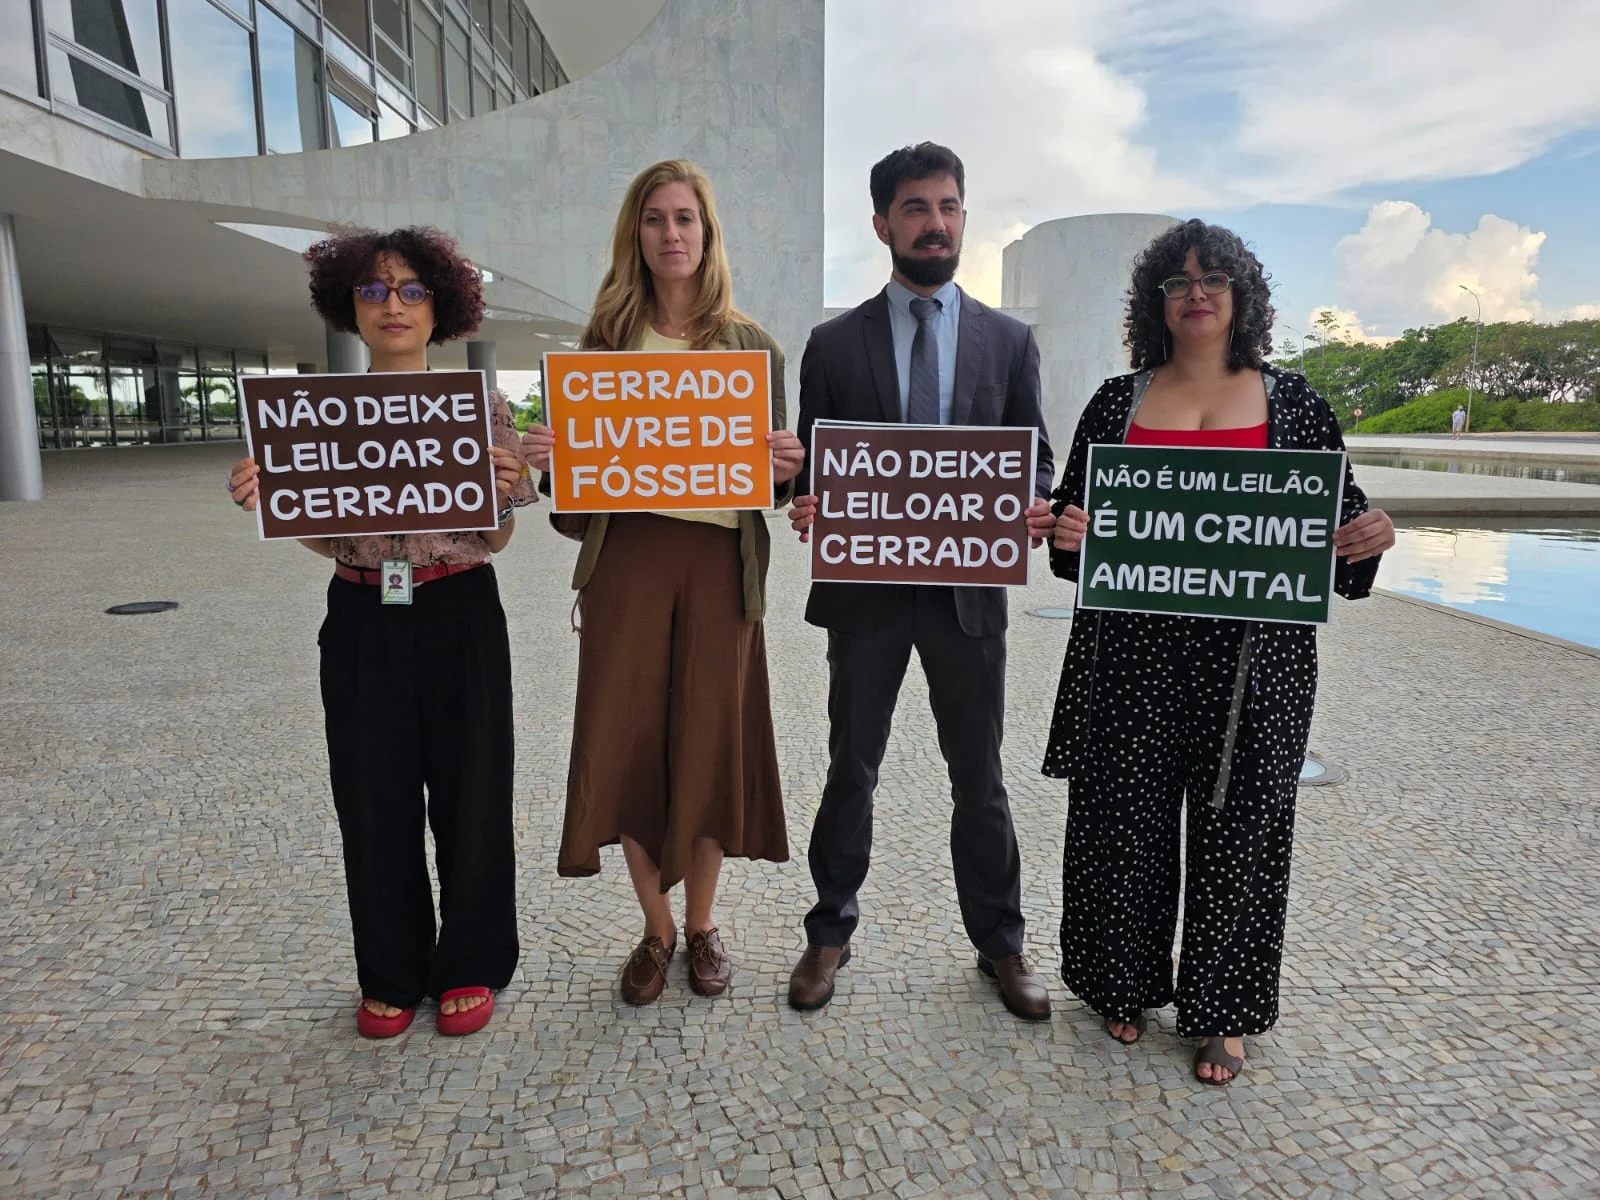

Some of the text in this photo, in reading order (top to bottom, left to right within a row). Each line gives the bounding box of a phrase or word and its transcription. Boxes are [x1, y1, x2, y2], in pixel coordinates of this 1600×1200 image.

[563, 370, 754, 401] CERRADO
[259, 391, 476, 428] NÃO DEIXE
[568, 416, 753, 448] LIVRE DE
[264, 438, 480, 473] LEILOAR O
[823, 442, 1021, 478] NÃO DEIXE
[572, 456, 753, 497] FÓSSEIS
[1096, 465, 1329, 496] NÃO É UM LEILÃO,
[270, 482, 483, 520] CERRADO
[823, 491, 1020, 521] LEILOAR O
[1094, 501, 1327, 547] É UM CRIME
[821, 534, 1018, 567] CERRADO
[1090, 563, 1321, 602] AMBIENTAL
